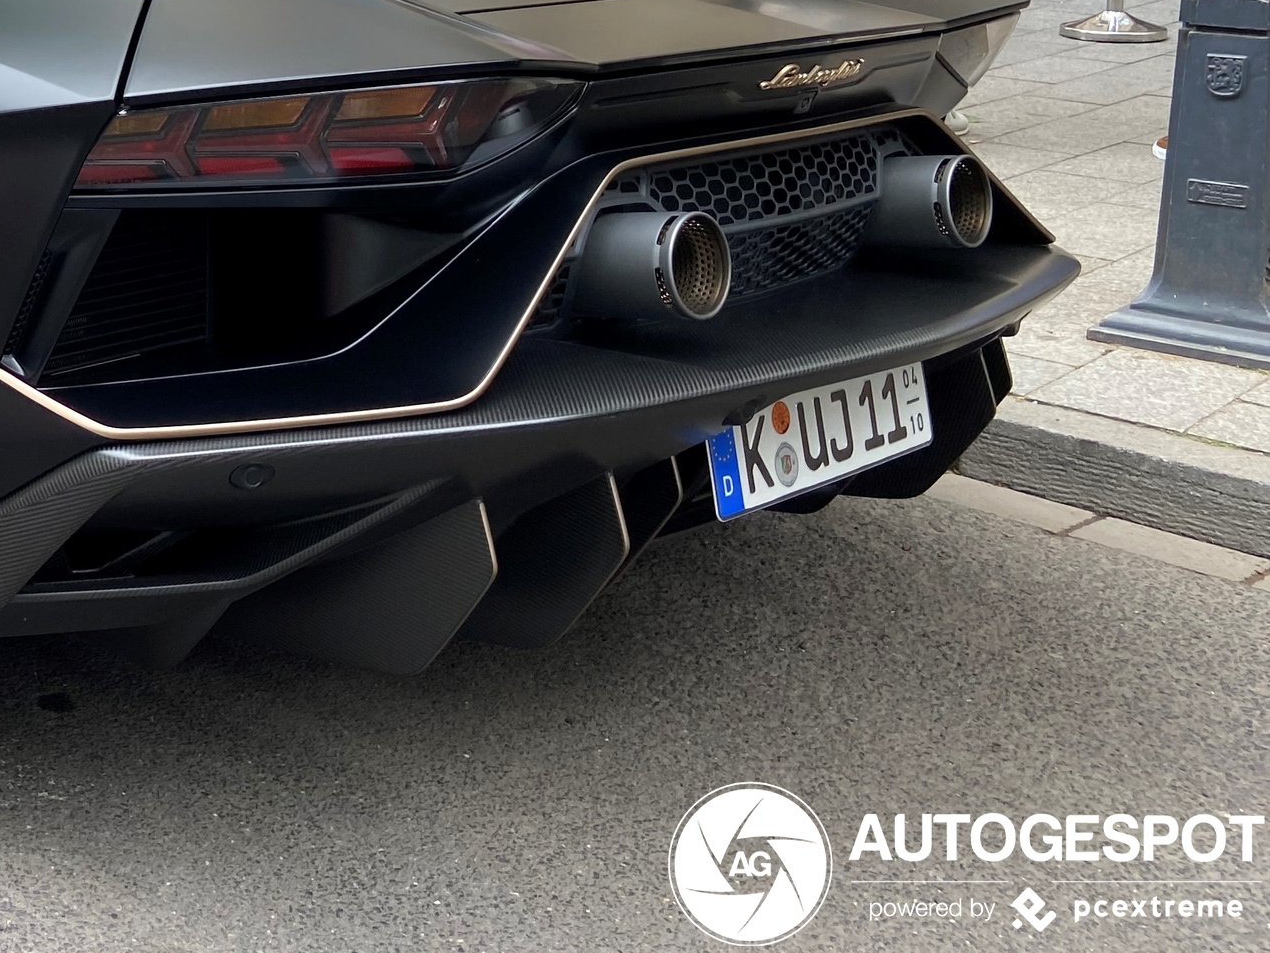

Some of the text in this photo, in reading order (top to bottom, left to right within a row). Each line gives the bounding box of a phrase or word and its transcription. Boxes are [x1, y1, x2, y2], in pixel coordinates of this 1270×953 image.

[902, 366, 918, 389] 04
[909, 412, 924, 435] 10
[722, 475, 734, 497] D
[740, 414, 775, 494] K
